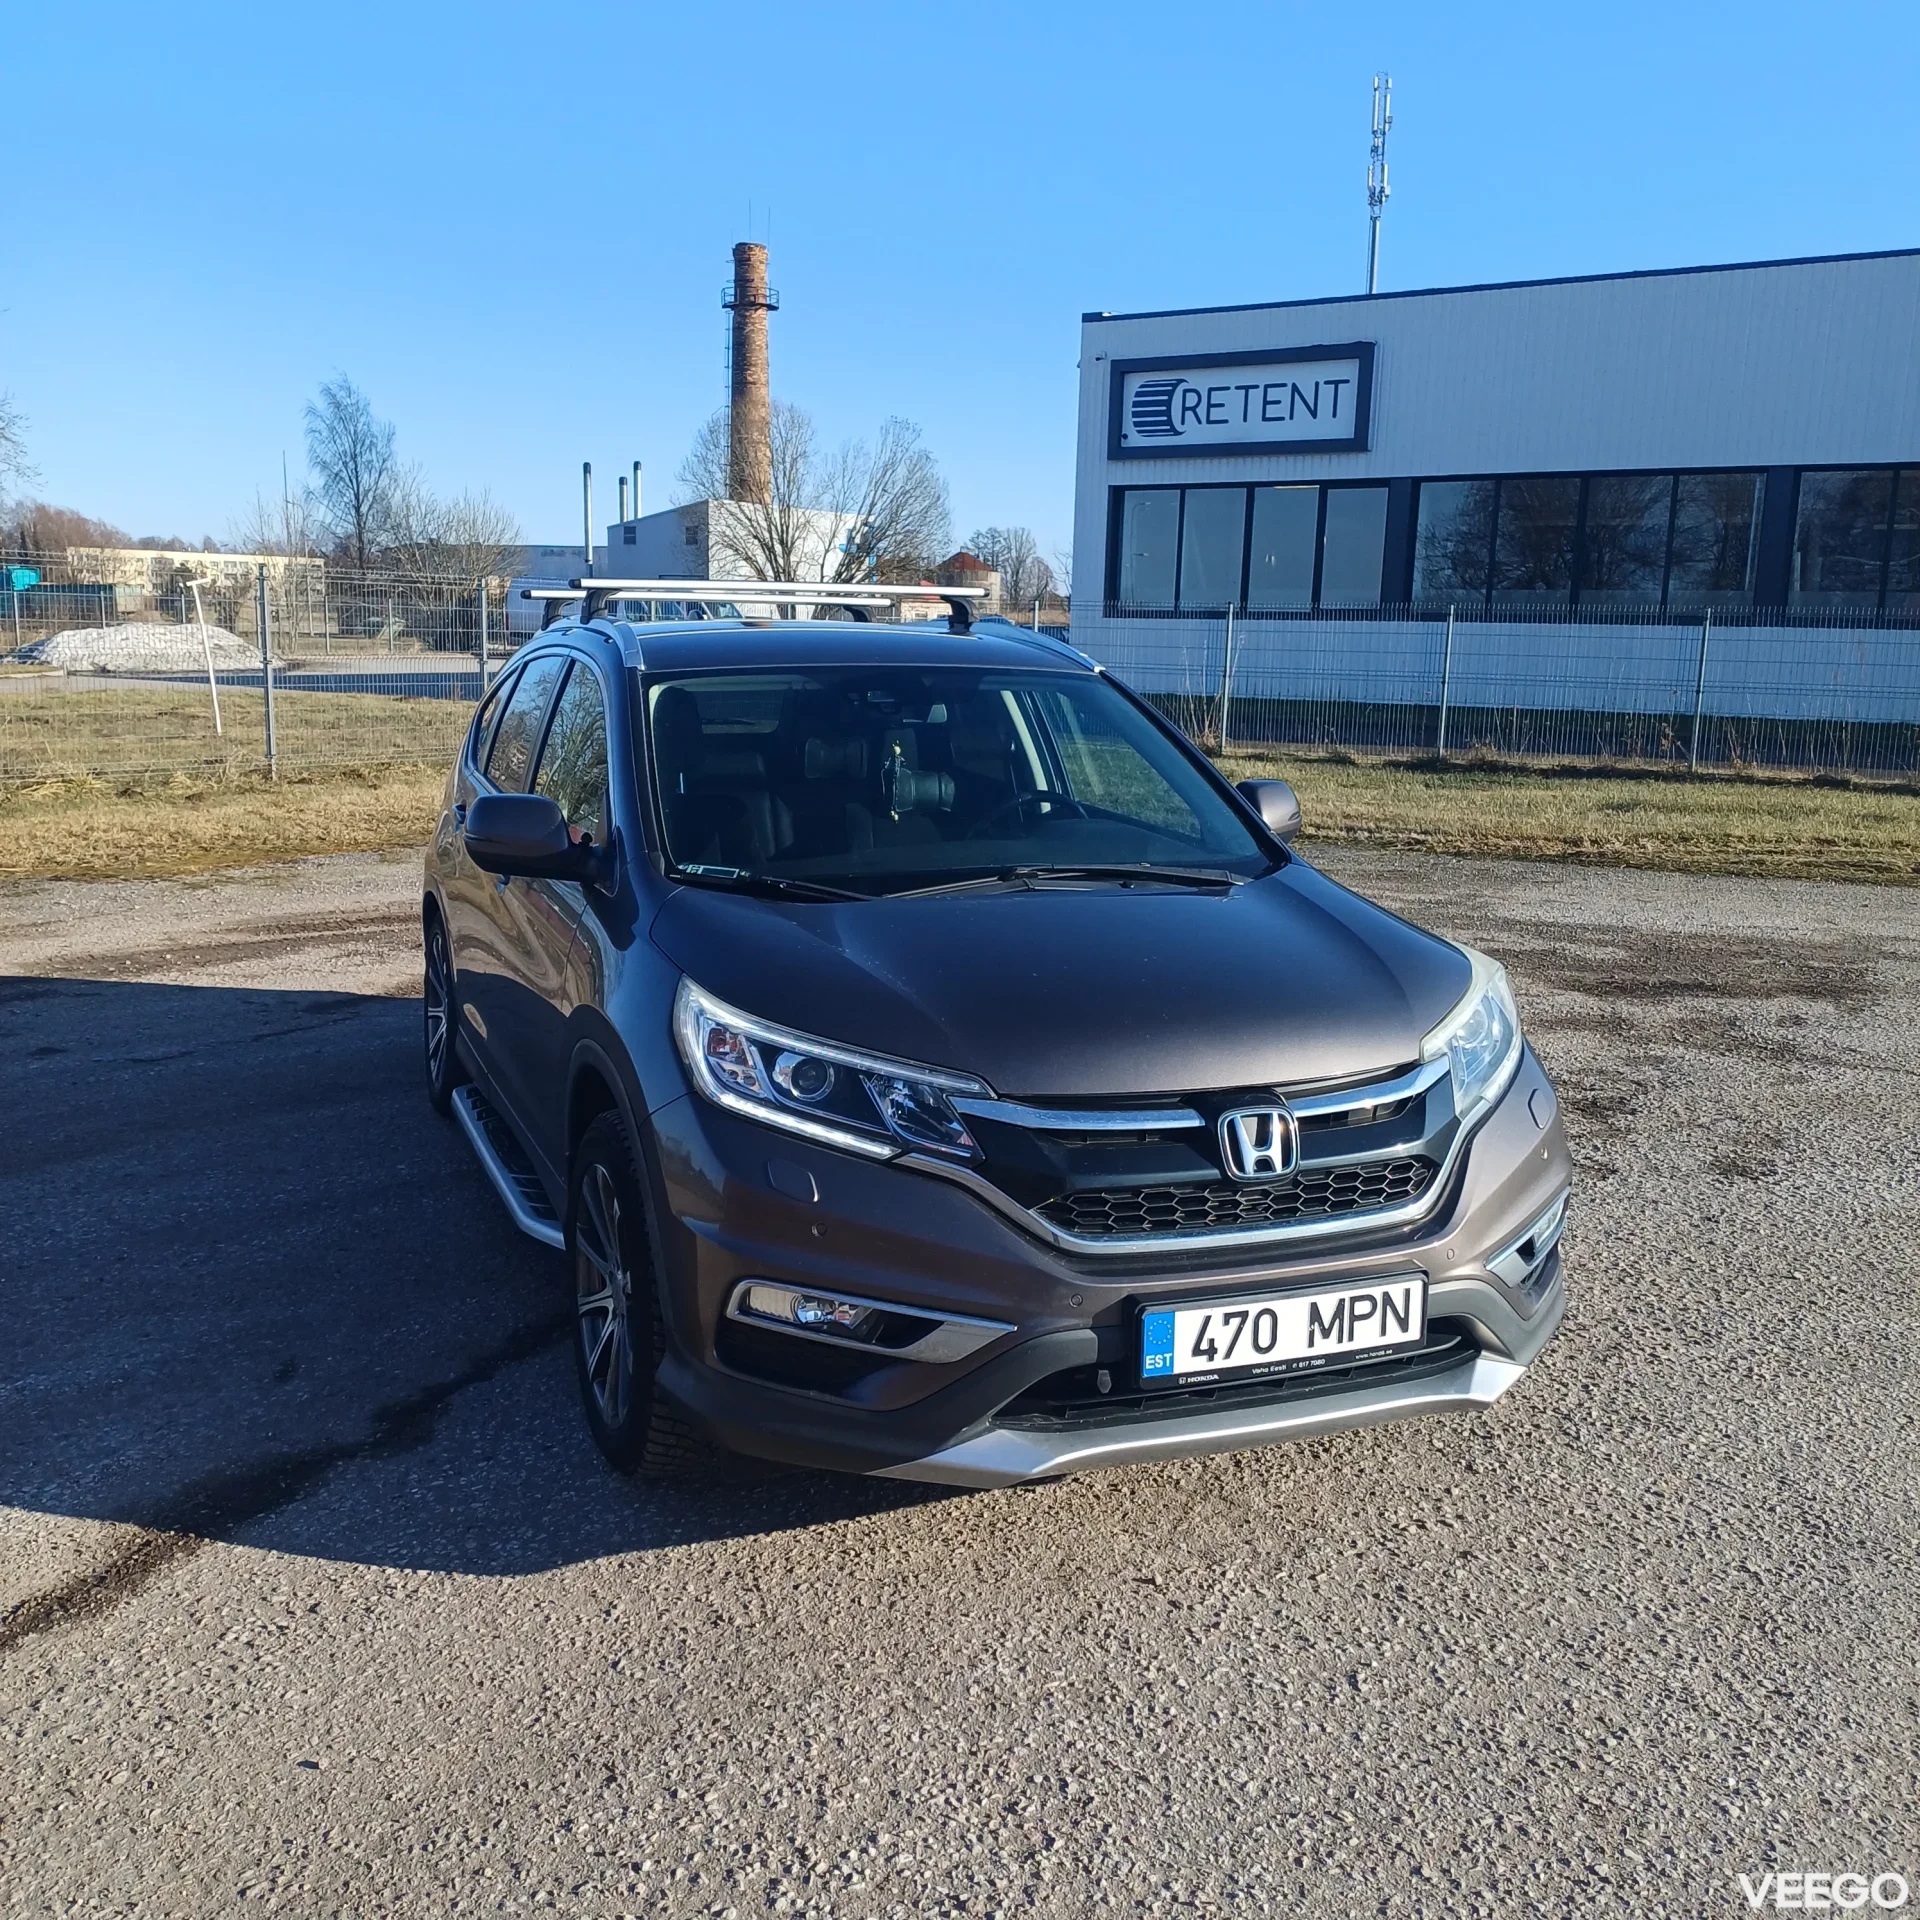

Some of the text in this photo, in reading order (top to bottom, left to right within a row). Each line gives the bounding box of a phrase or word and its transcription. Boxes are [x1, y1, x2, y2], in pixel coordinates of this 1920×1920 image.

[1180, 378, 1351, 426] RETENT
[1191, 1287, 1411, 1362] 470 MPN
[1145, 1352, 1173, 1370] EST
[1187, 1374, 1219, 1384] HONDA
